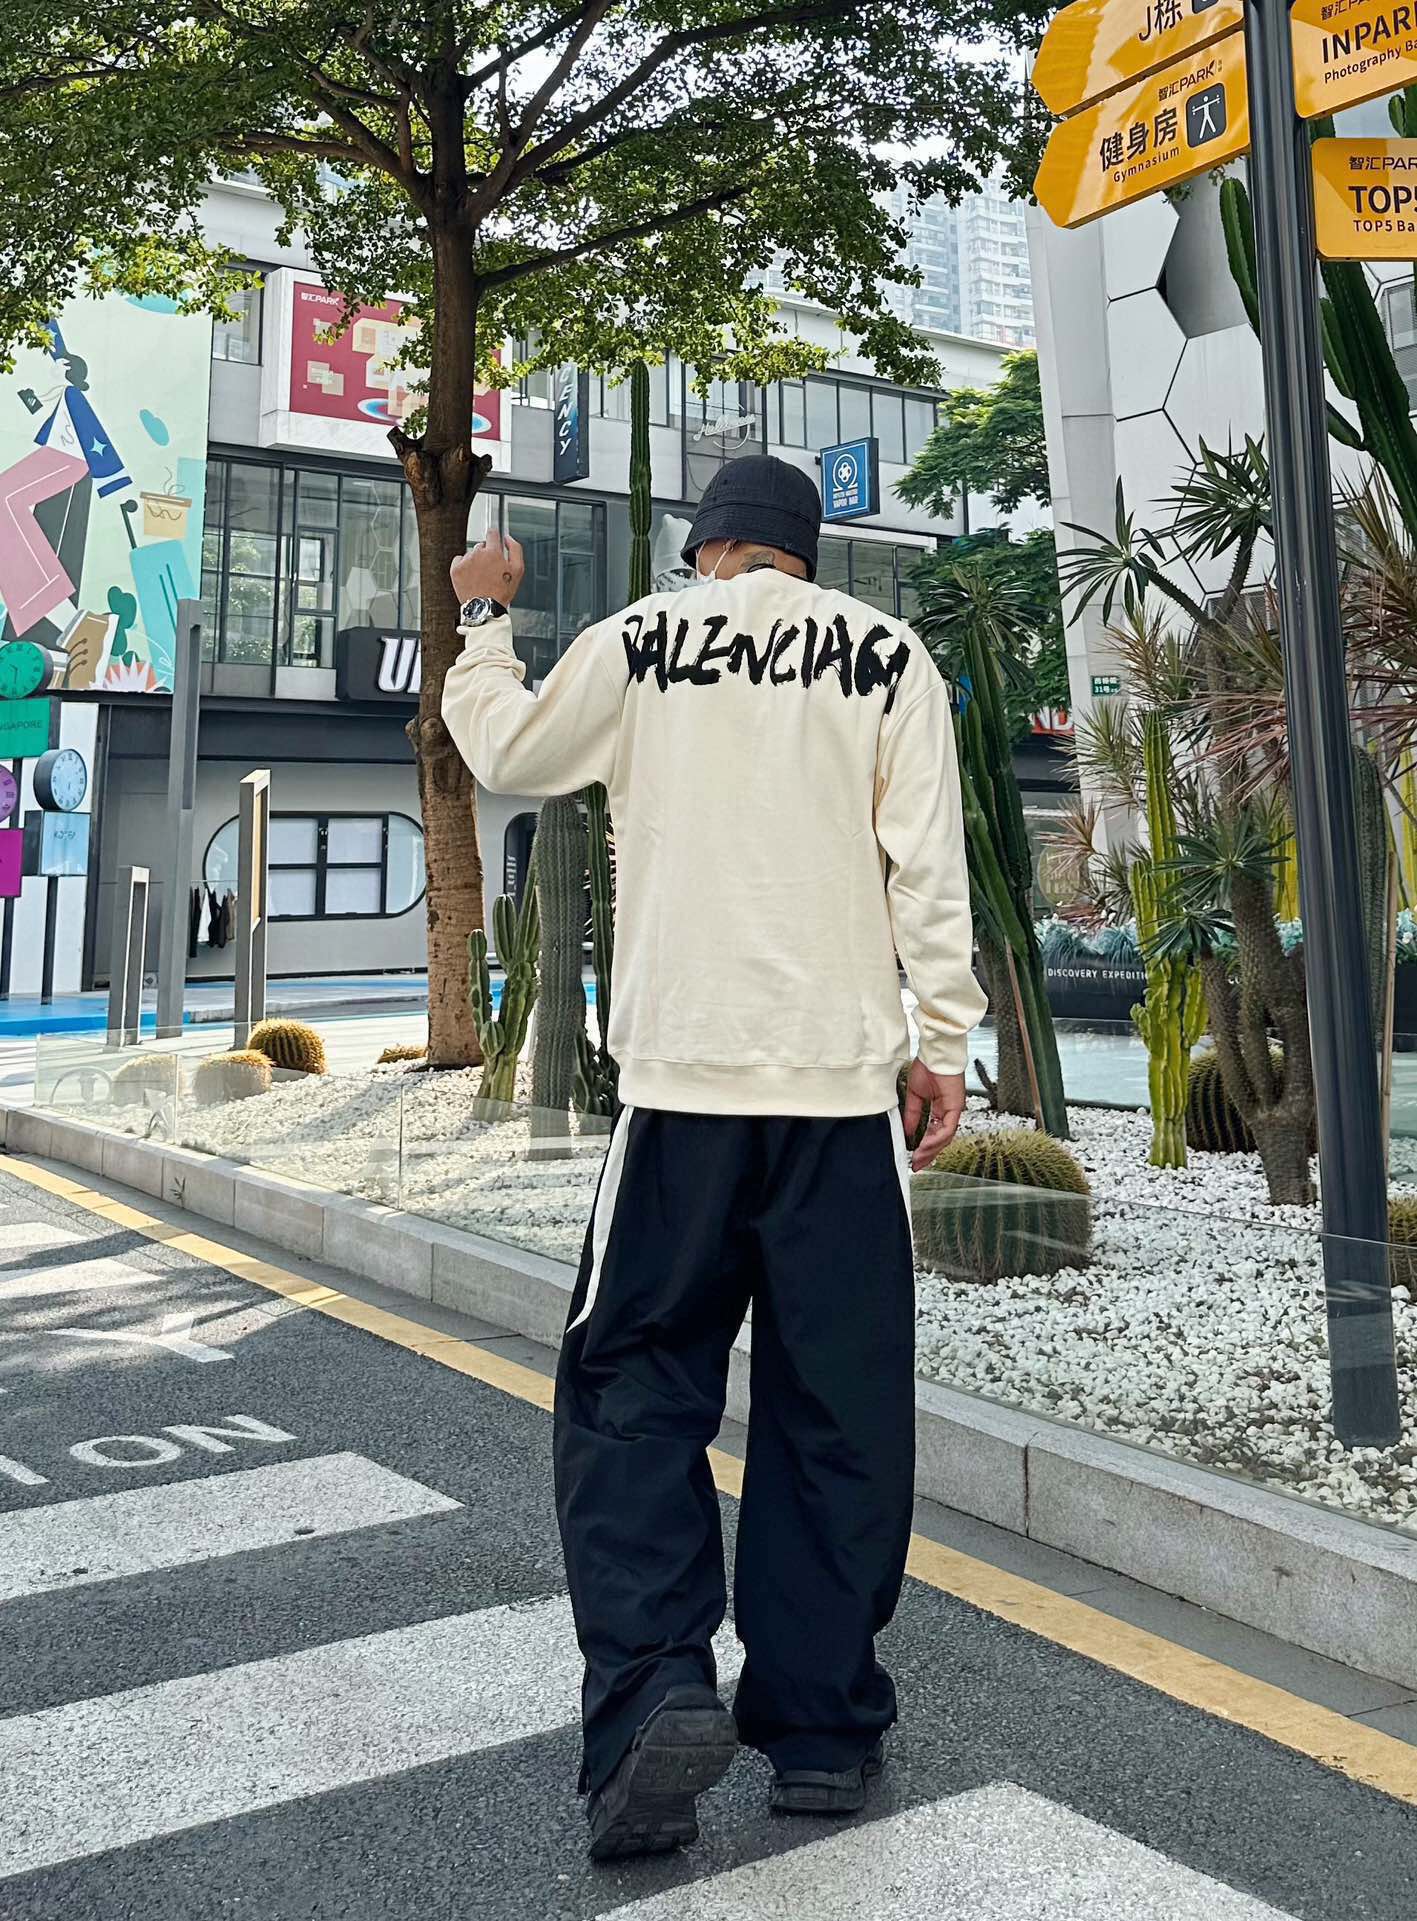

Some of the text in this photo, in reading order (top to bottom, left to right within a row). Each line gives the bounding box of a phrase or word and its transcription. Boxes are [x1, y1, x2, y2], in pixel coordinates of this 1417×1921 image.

[1322, 1, 1417, 63] INPAR
[1158, 59, 1215, 102] 智汇PARK
[1324, 45, 1401, 84] Photography
[1100, 107, 1178, 172] 健身房
[1113, 147, 1180, 183] Gymnasium
[1353, 220, 1393, 232] TOP5
[1047, 968, 1098, 979] DISCOVERY
